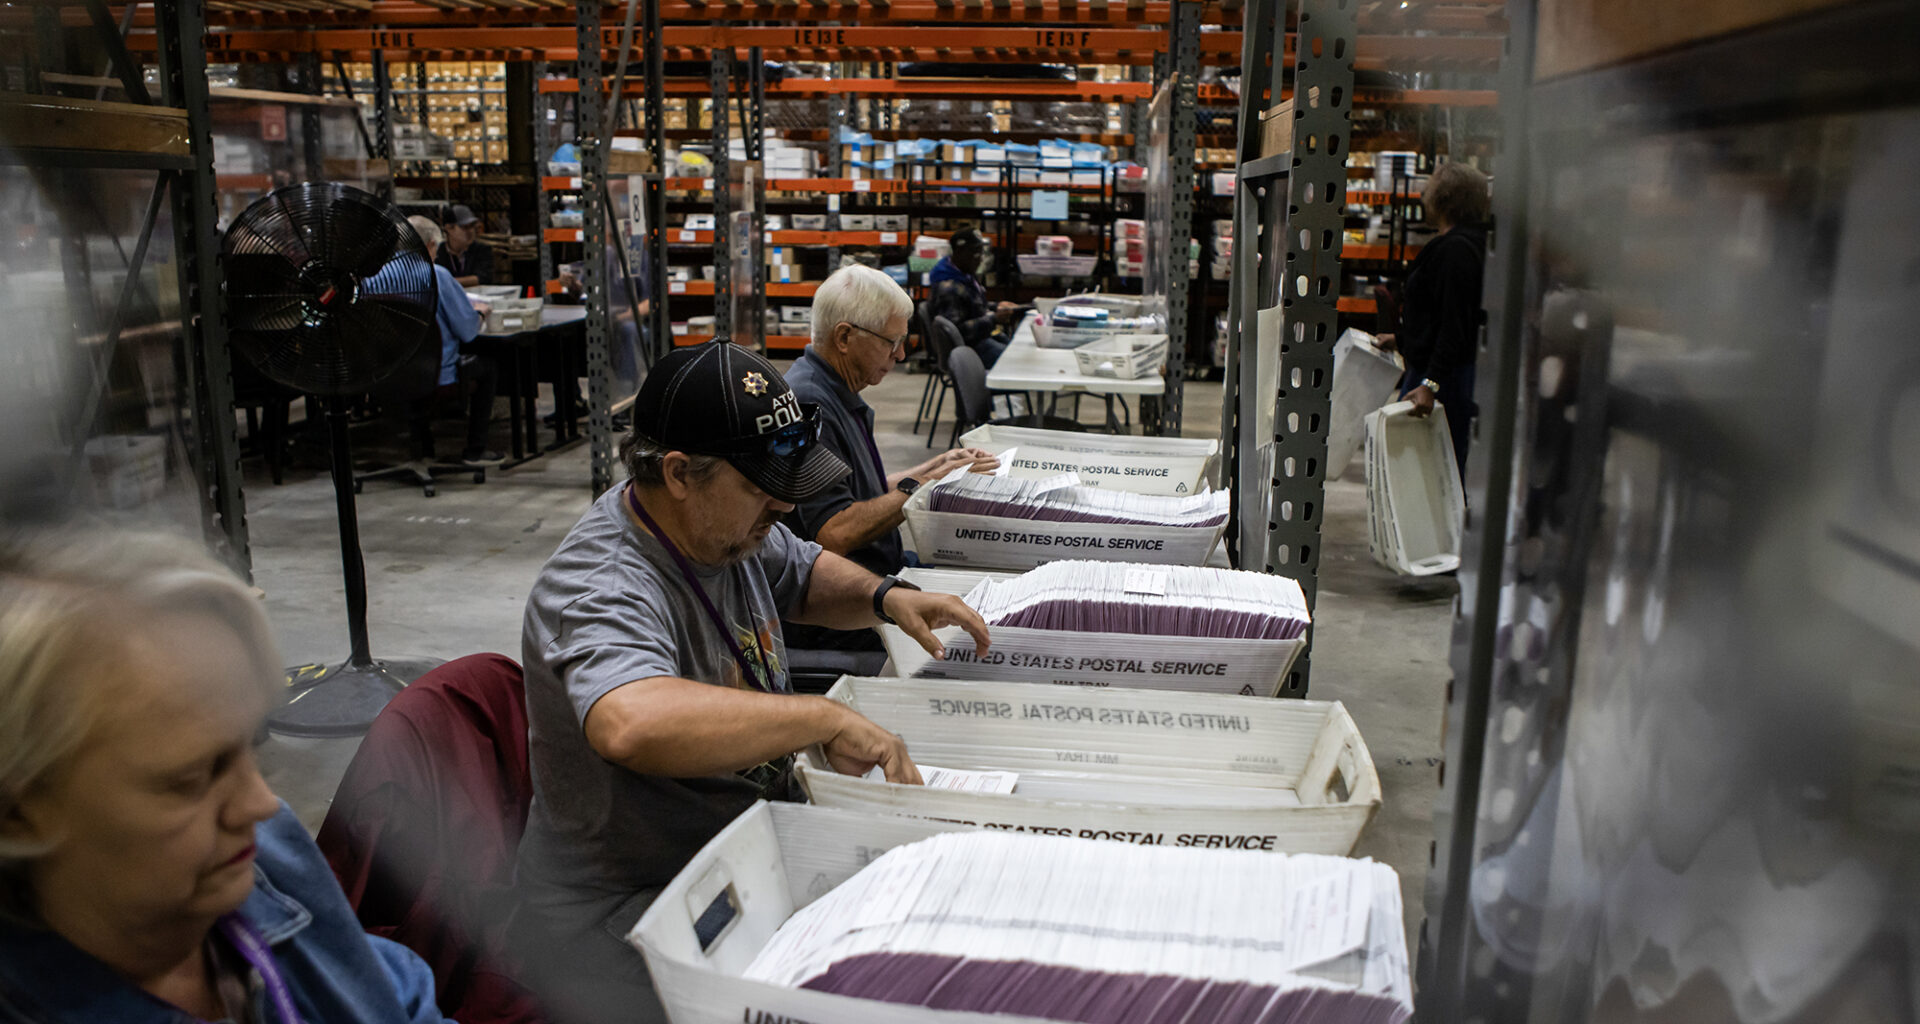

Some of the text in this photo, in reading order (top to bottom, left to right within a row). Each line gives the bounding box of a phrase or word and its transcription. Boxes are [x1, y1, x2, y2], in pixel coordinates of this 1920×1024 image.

[633, 194, 640, 222] 8
[1012, 459, 1169, 477] NITED STATES POSTAL SERVICE
[955, 528, 1164, 551] UNITED STATES POSTAL SERVICE
[1009, 652, 1075, 671] STATES
[1078, 657, 1146, 674] POSTAL
[1150, 660, 1228, 677] SERVICE
[1174, 832, 1278, 851] SERVICE
